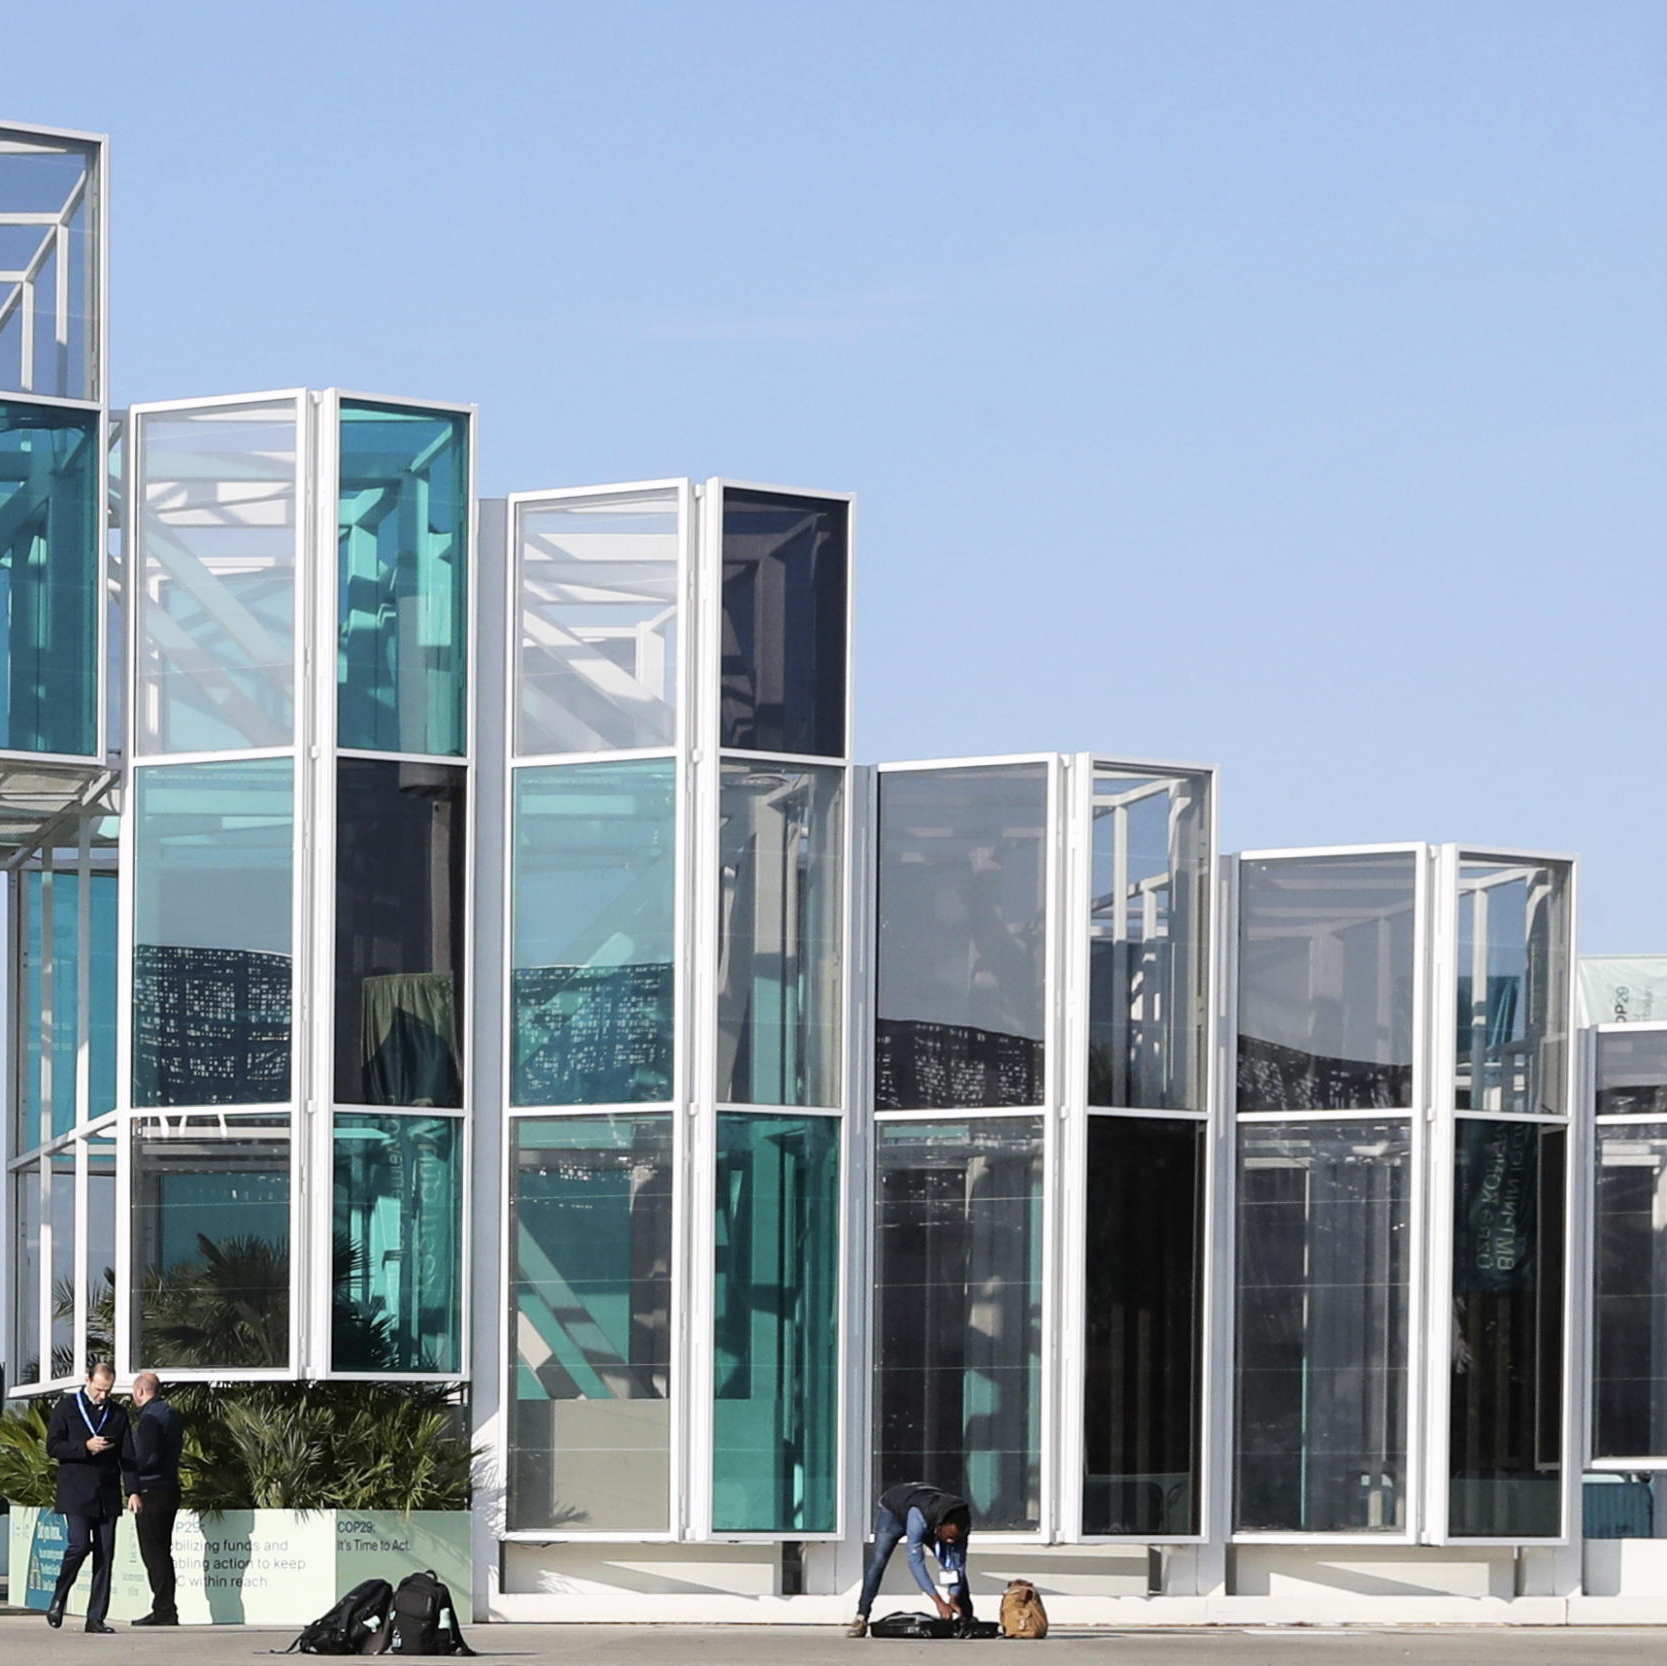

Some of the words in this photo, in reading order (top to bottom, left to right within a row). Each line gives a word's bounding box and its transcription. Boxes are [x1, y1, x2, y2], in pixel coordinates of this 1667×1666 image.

[1614, 986, 1629, 1022] OP29
[337, 1521, 376, 1533] COP29:
[171, 1539, 220, 1553] bilizing
[223, 1539, 260, 1551] funds
[264, 1540, 288, 1551] and
[354, 1539, 378, 1551] Time
[380, 1540, 390, 1551] to
[213, 1557, 254, 1569] action
[257, 1557, 271, 1569] to
[273, 1557, 306, 1571] keep
[189, 1576, 227, 1587] within
